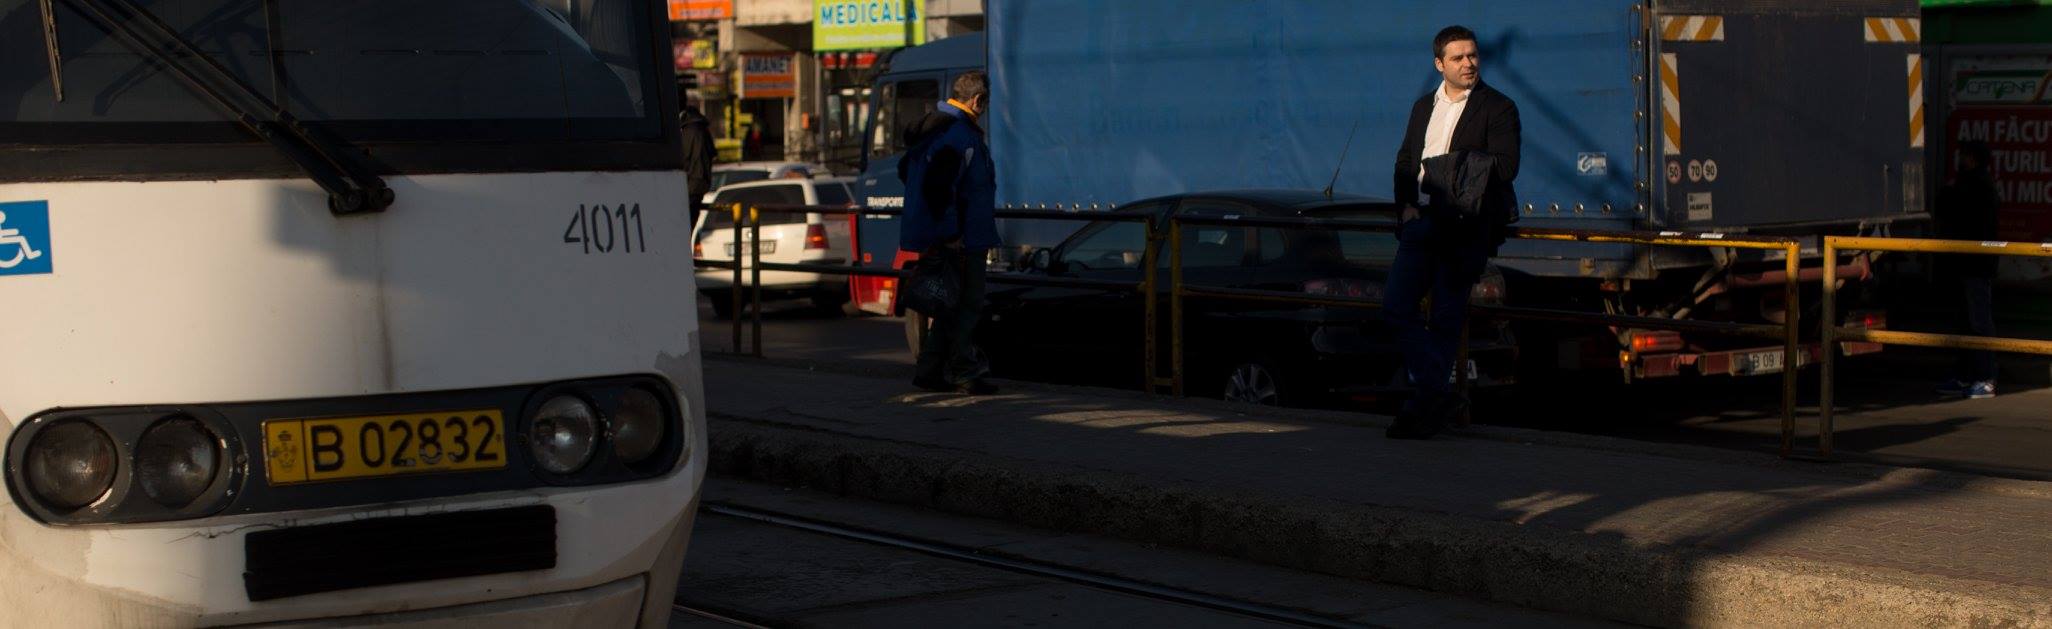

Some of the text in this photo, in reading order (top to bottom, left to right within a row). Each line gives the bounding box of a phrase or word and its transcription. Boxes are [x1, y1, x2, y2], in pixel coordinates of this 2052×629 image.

[1958, 113, 2052, 144] AM FĂCU
[1669, 165, 1679, 178] 50
[1691, 165, 1700, 177] 70
[1705, 164, 1715, 177] 90
[564, 203, 645, 254] 4011
[1763, 353, 1775, 368] 09
[311, 414, 499, 473] B 02832
